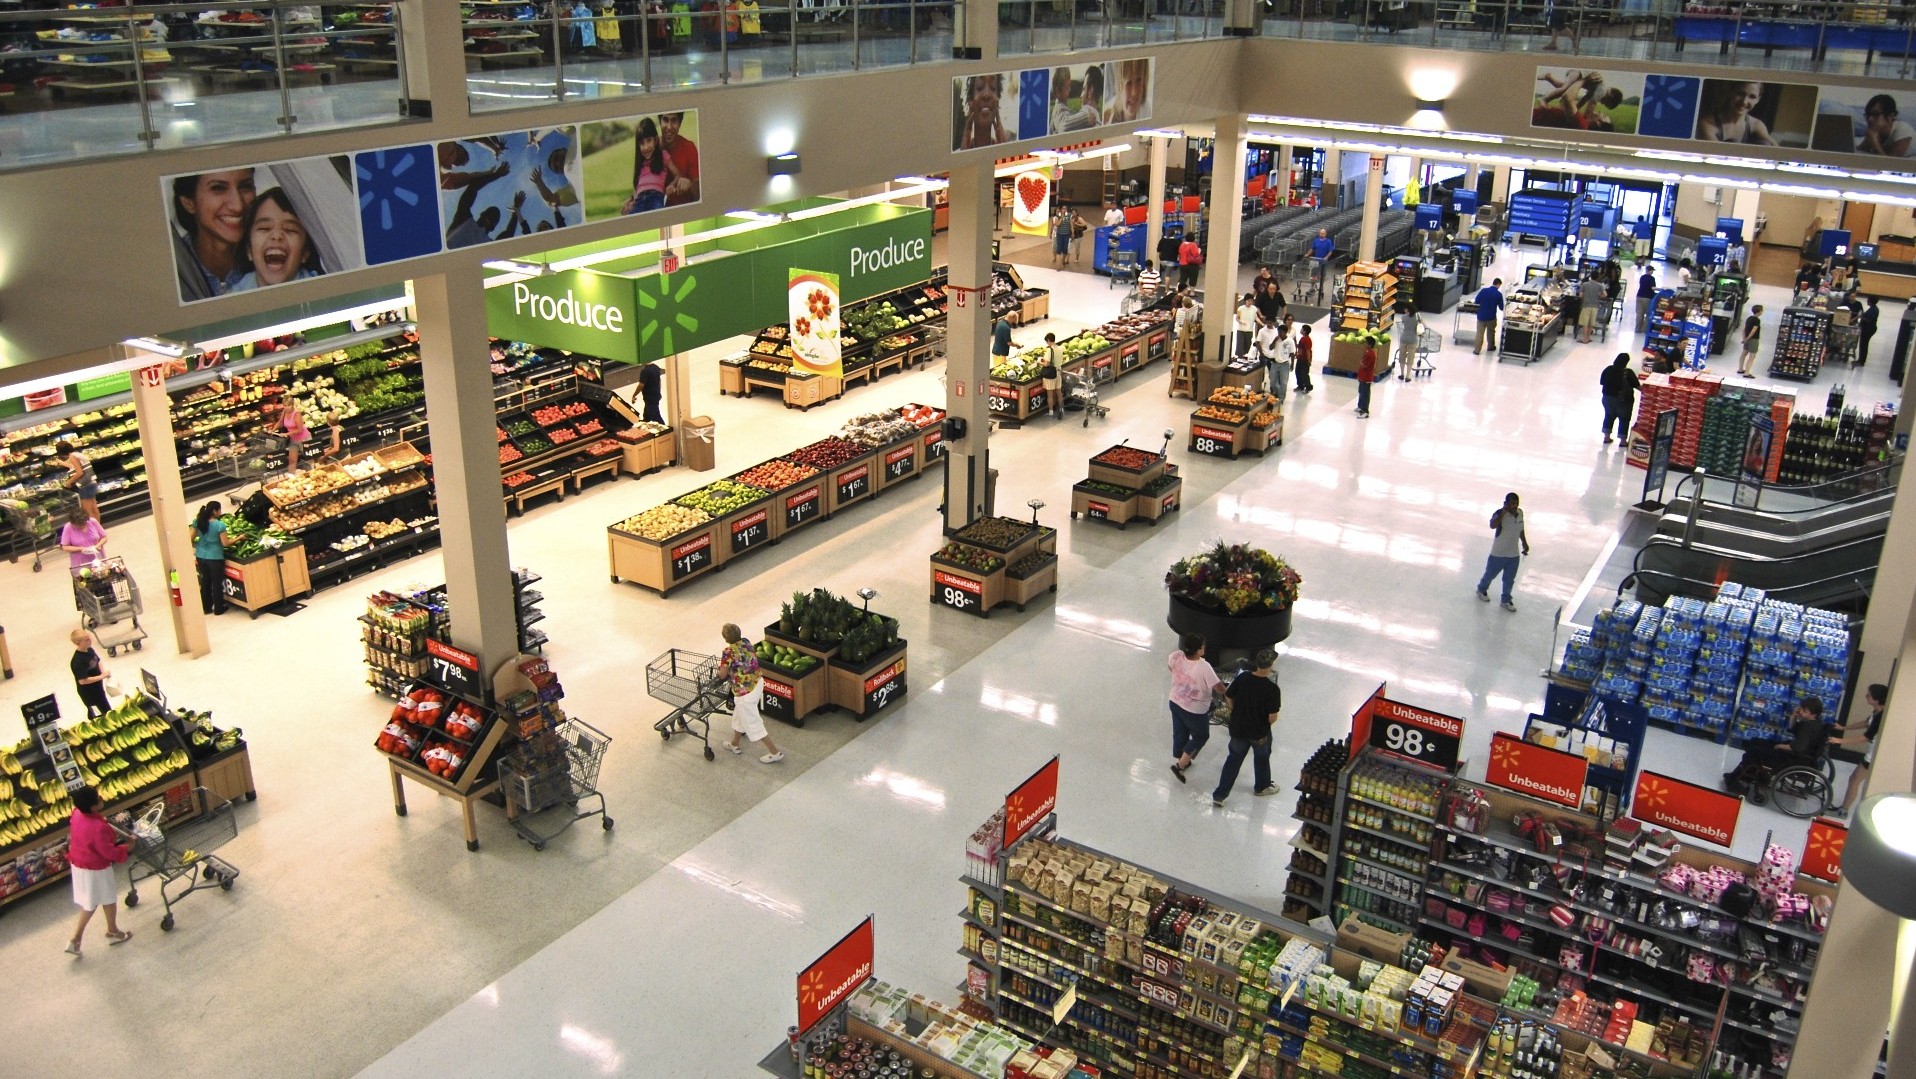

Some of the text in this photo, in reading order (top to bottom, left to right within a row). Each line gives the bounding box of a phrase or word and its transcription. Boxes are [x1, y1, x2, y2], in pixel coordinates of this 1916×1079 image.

[1453, 203, 1461, 211] 18
[1429, 220, 1438, 229] 17
[1580, 217, 1589, 225] 20
[664, 257, 677, 273] EXIT
[850, 237, 925, 277] Produce
[1713, 254, 1725, 263] 21
[514, 282, 623, 333] Produce
[1201, 428, 1233, 440] Unbeatable
[739, 511, 766, 527] Unbeatable
[680, 536, 709, 553] Unbeatable
[944, 574, 980, 591] Unbeatable
[438, 644, 471, 663] Unbeatable
[873, 668, 895, 686] Rollback
[1392, 705, 1459, 732] Unbeatable
[1508, 772, 1577, 800] Unbeatable
[1016, 796, 1055, 832] Unbeatable
[1655, 811, 1728, 840] Unbeatable
[817, 962, 870, 1011] Unbeatable
